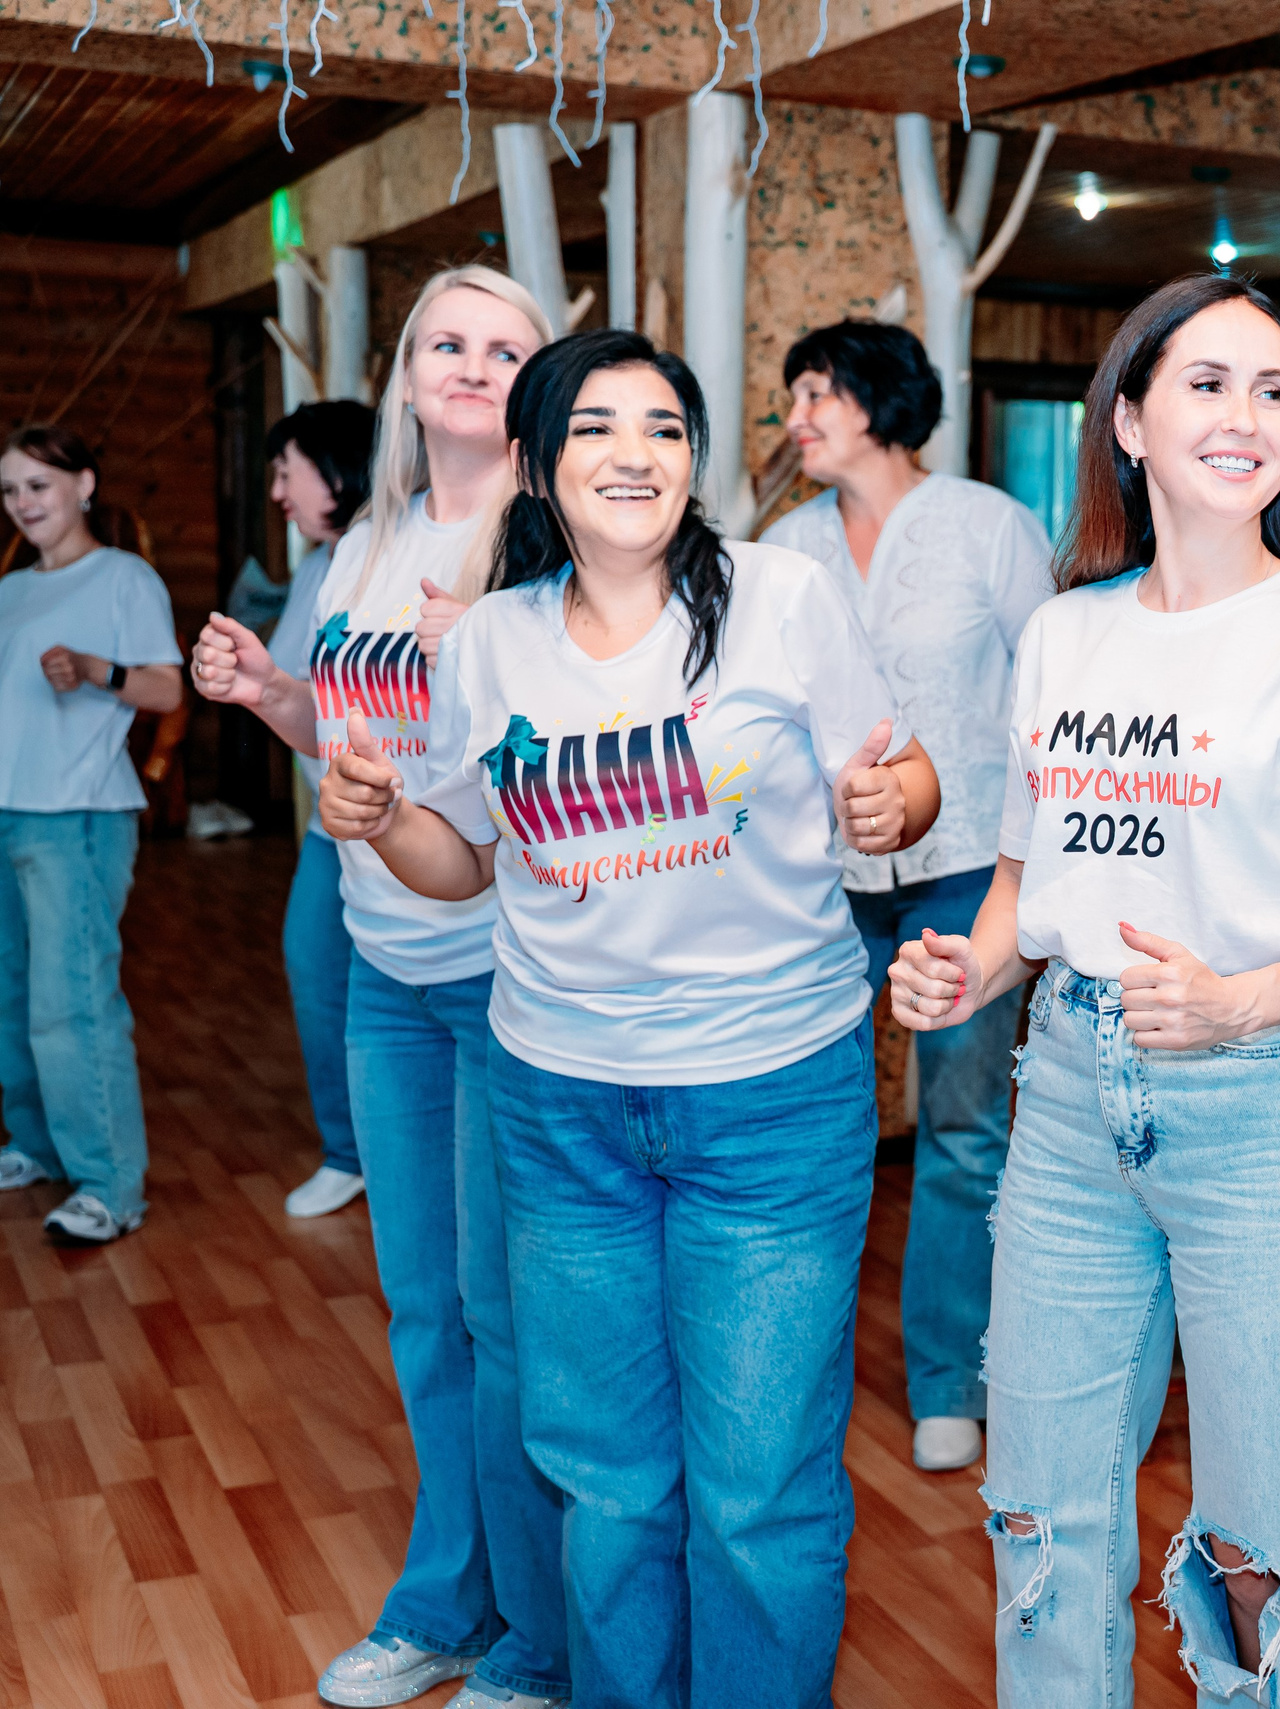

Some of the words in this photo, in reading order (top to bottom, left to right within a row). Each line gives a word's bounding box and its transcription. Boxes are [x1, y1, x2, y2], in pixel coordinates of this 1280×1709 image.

[311, 631, 431, 722] МАМА
[1048, 710, 1179, 757] МАМА
[499, 713, 709, 845] МАМА
[1062, 811, 1165, 858] 2026
[522, 835, 731, 903] Выпускника
